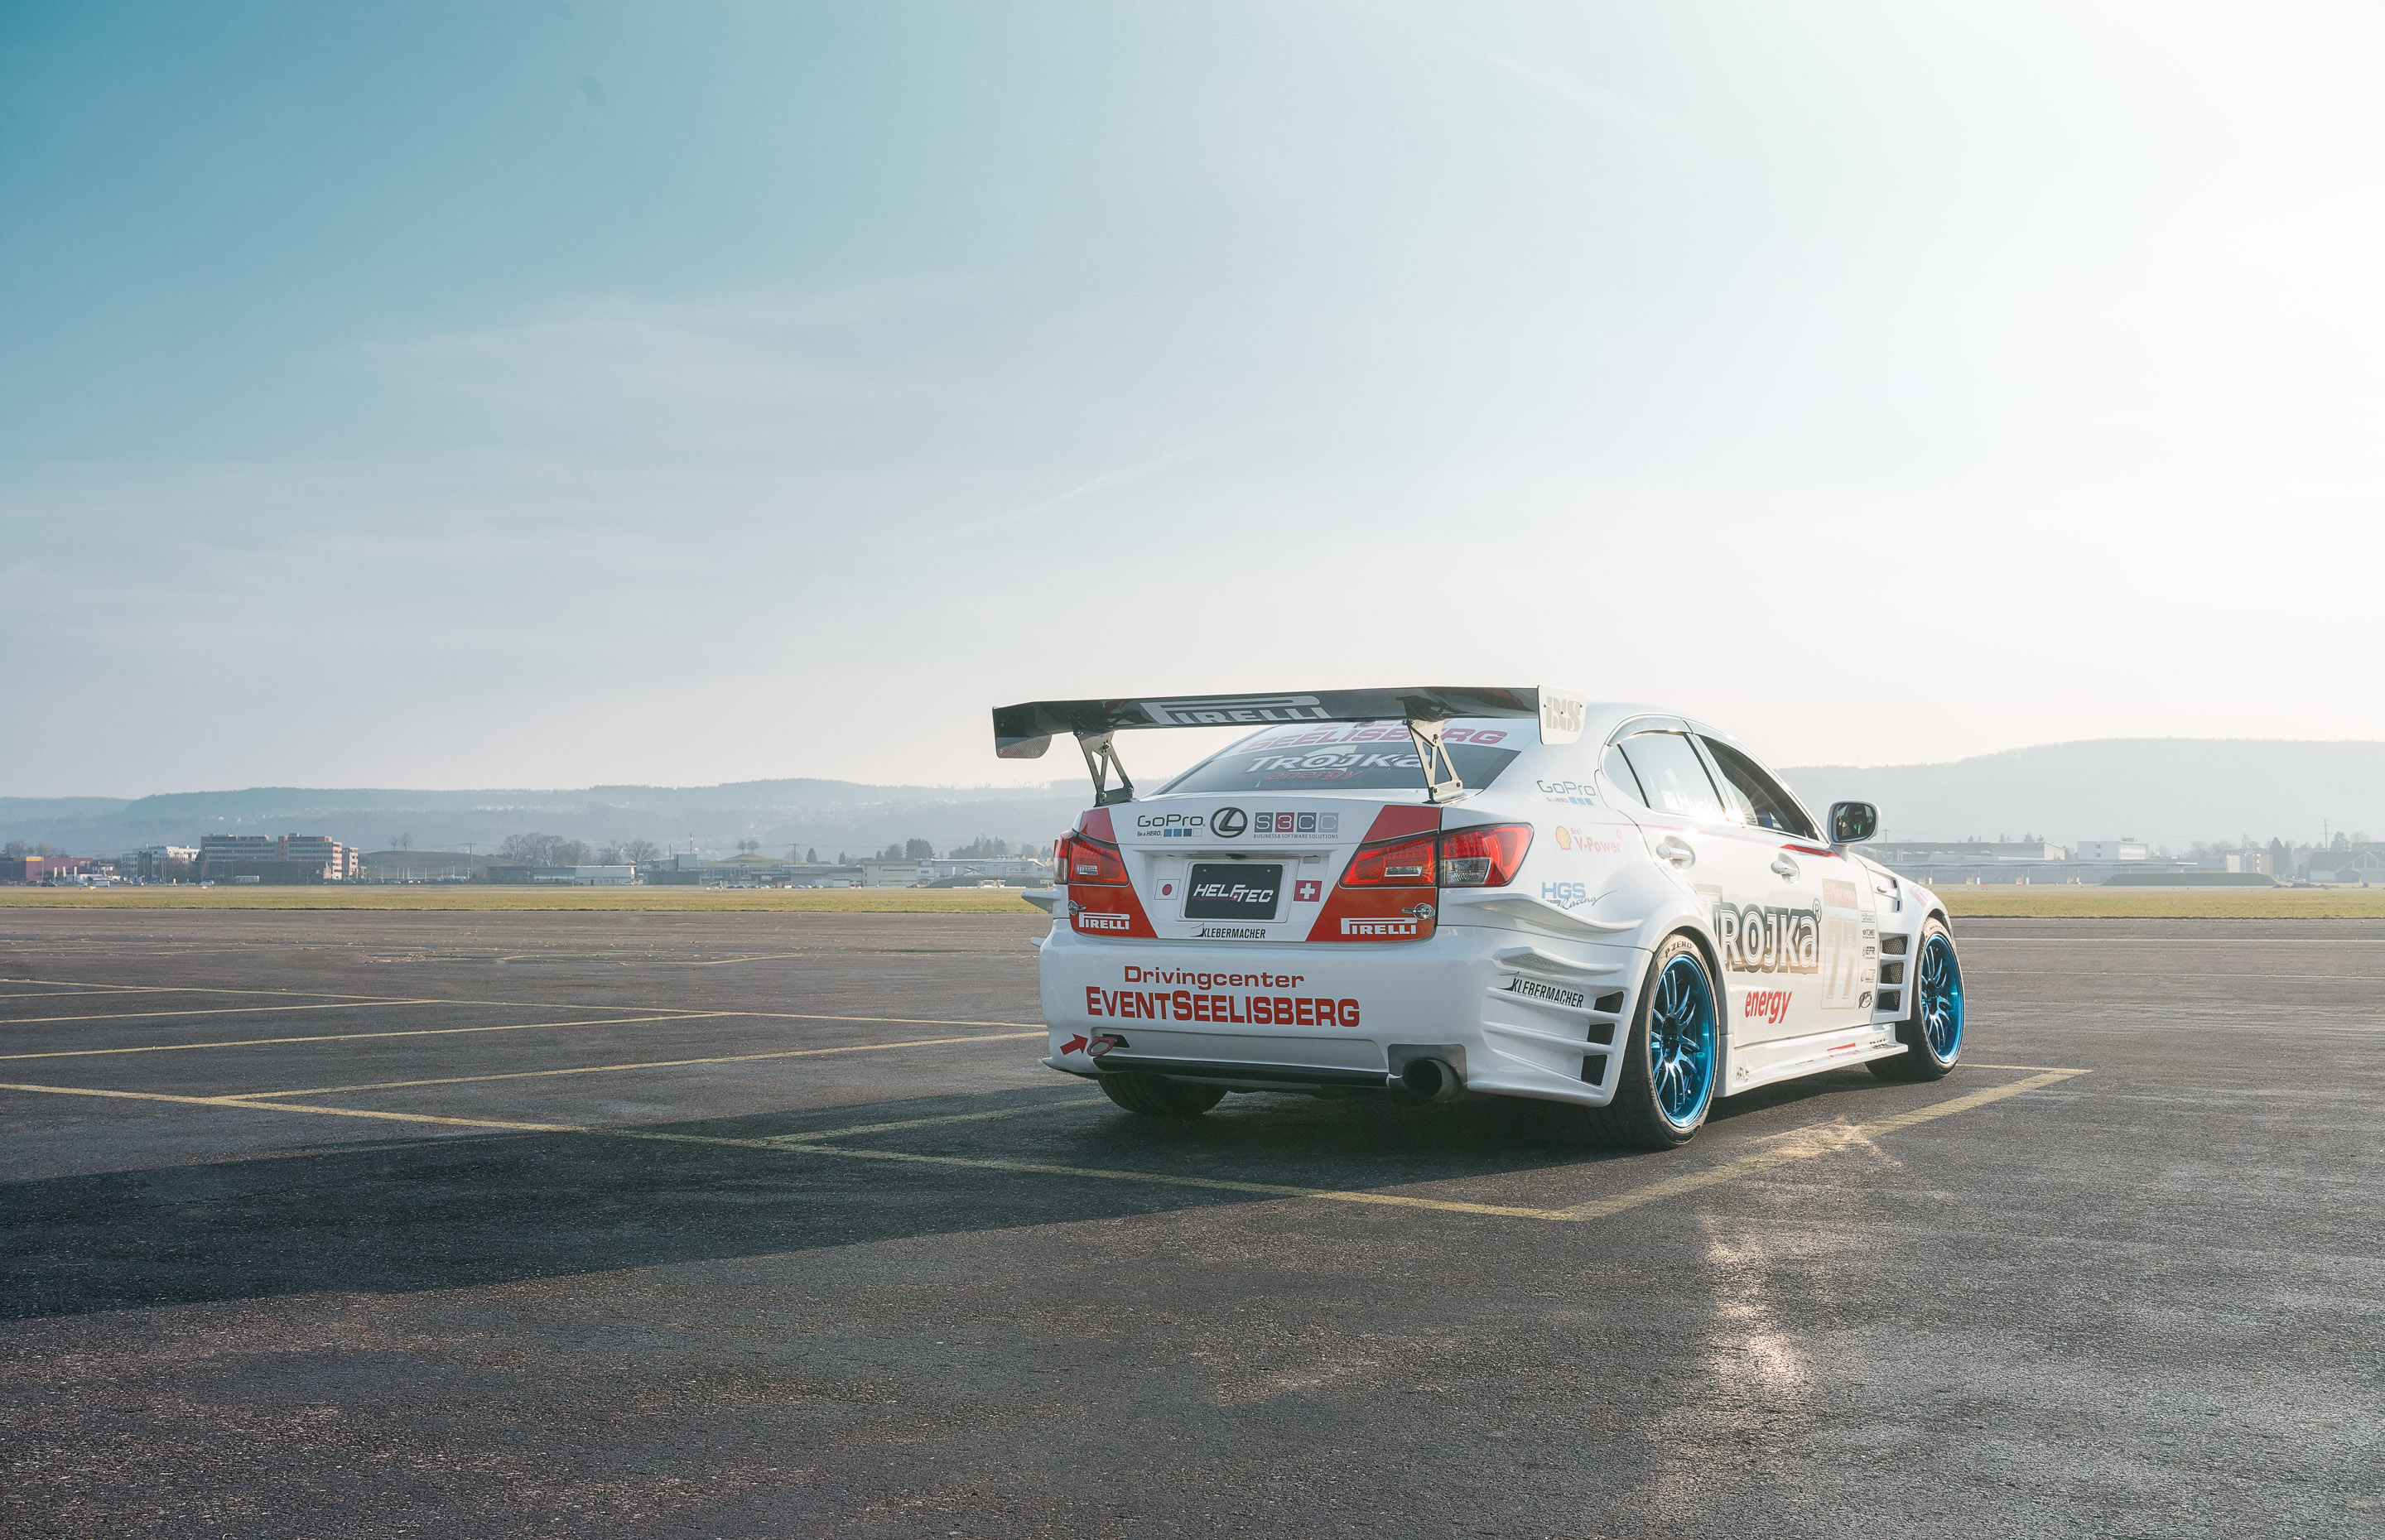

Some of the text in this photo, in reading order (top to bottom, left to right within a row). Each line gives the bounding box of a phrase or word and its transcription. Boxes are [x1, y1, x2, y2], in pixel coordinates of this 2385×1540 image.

[1140, 695, 1332, 724] PIRELLI
[1265, 769, 1364, 783] energy
[1573, 835, 1621, 854] V-Power
[1541, 882, 1586, 899] HGS
[1078, 912, 1130, 930] PIRELLI
[1341, 917, 1418, 935] PIRELLI
[1202, 927, 1266, 939] KLEBERMACHER
[1124, 965, 1305, 990] Drivingcenter
[1512, 978, 1584, 1008] KLEBERMACHER
[1745, 990, 1793, 1023] energy
